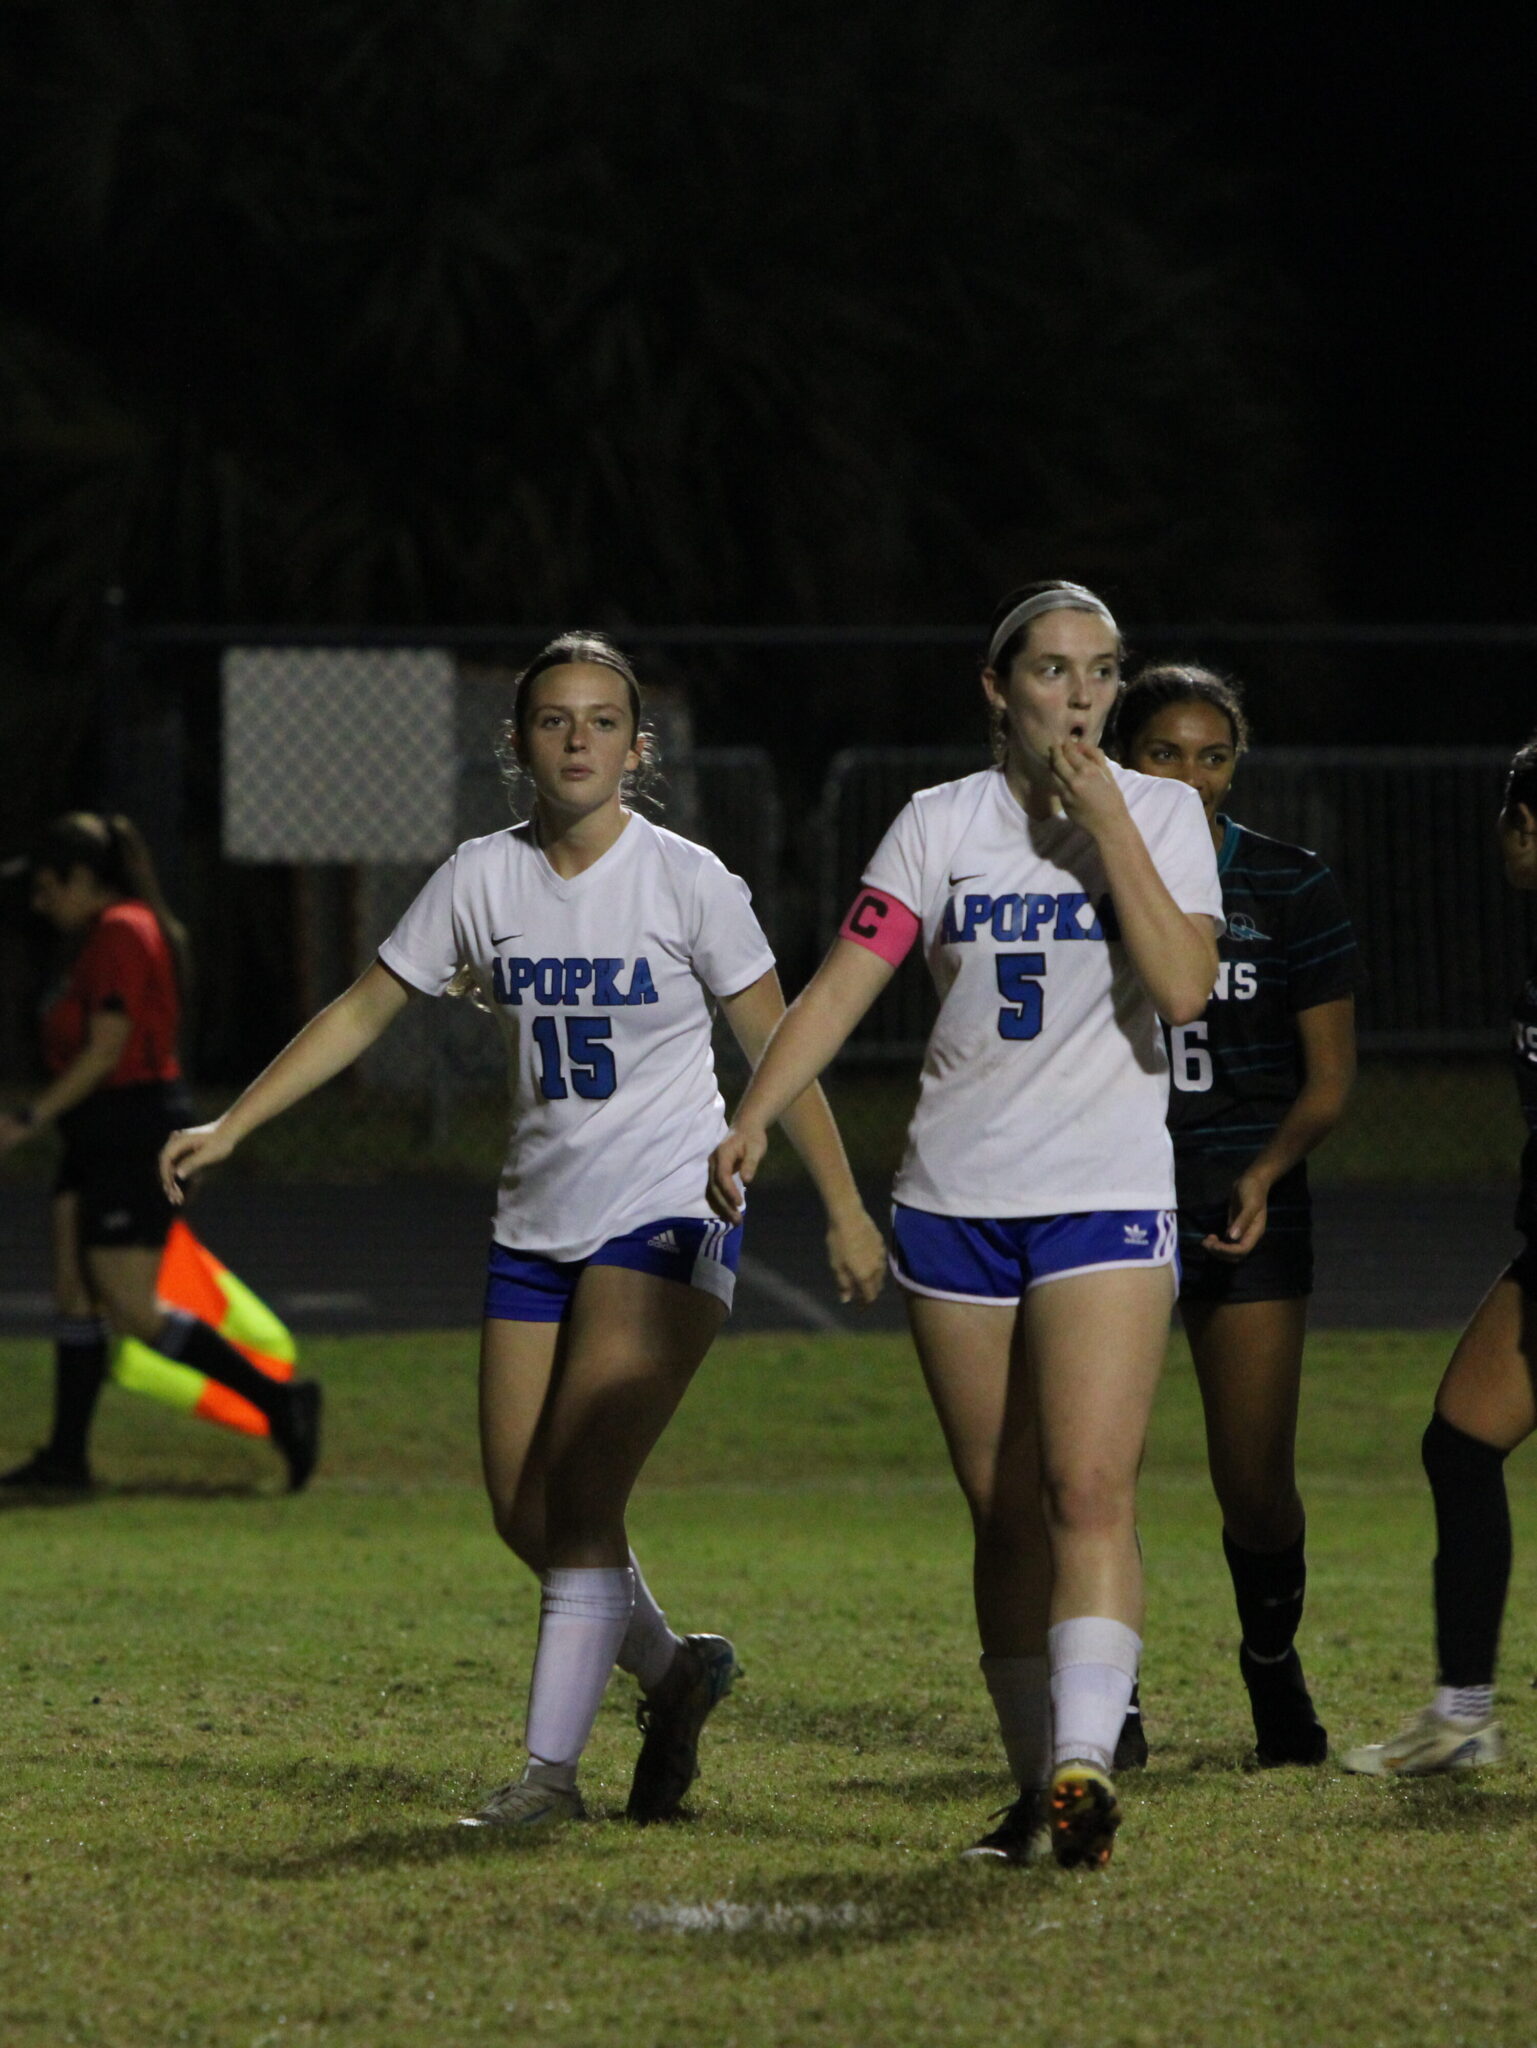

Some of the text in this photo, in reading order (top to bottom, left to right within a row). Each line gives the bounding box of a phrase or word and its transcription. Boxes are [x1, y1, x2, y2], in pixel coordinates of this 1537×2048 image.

[848, 894, 889, 940] C
[492, 956, 659, 1006] APOPKA
[994, 951, 1047, 1041] 5
[531, 1015, 618, 1101] 15
[1170, 1020, 1214, 1093] 6
